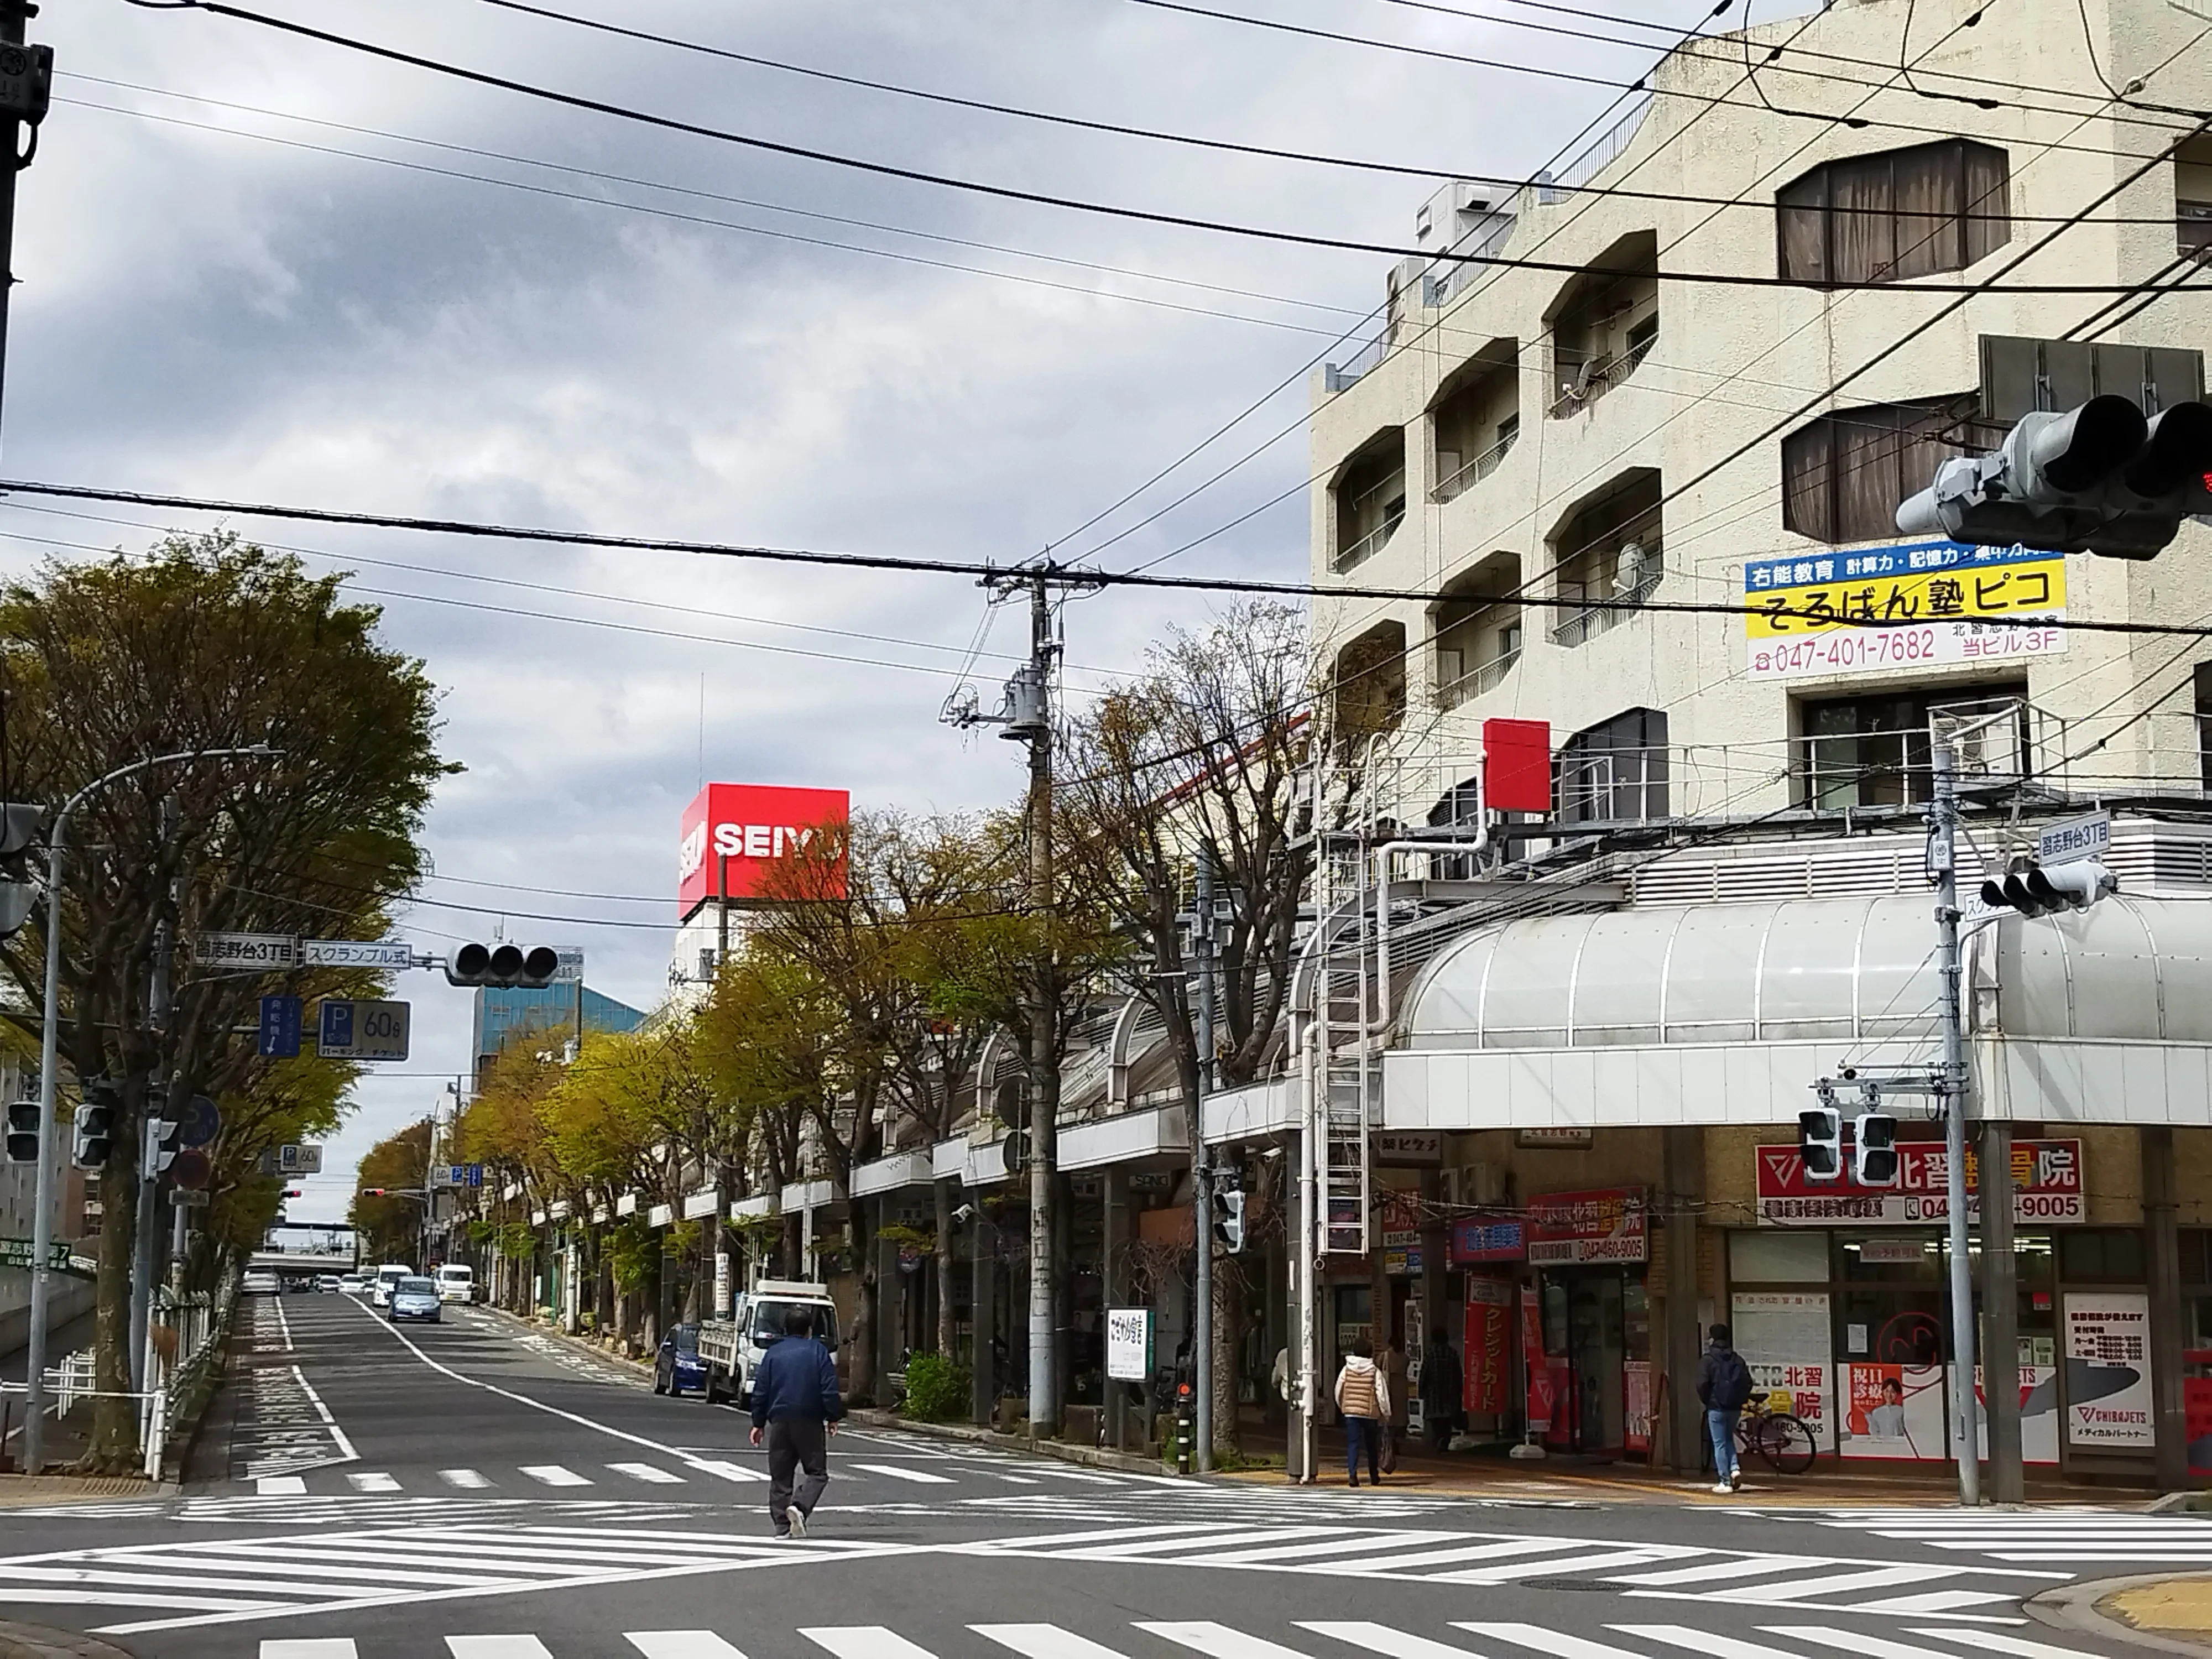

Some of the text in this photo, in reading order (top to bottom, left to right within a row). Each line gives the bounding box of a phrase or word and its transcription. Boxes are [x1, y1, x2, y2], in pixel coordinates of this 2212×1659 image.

[1846, 541, 2054, 575] 計算力・記憶力・集中力
[1765, 572, 2050, 630] そろばん塾ピコ
[1777, 629, 1934, 671] 047-401-7682
[1963, 630, 2058, 656] 当ビル3F
[2042, 821, 2107, 857] 習志野台3丁目
[196, 939, 293, 962] 習志野台3丁目
[309, 946, 406, 964] スクランブル式
[333, 1007, 347, 1030] P
[1481, 1307, 1502, 1410] クレジットカード
[1785, 1366, 1823, 1387] 北習
[2077, 1428, 2148, 1438] メディカルパートナー
